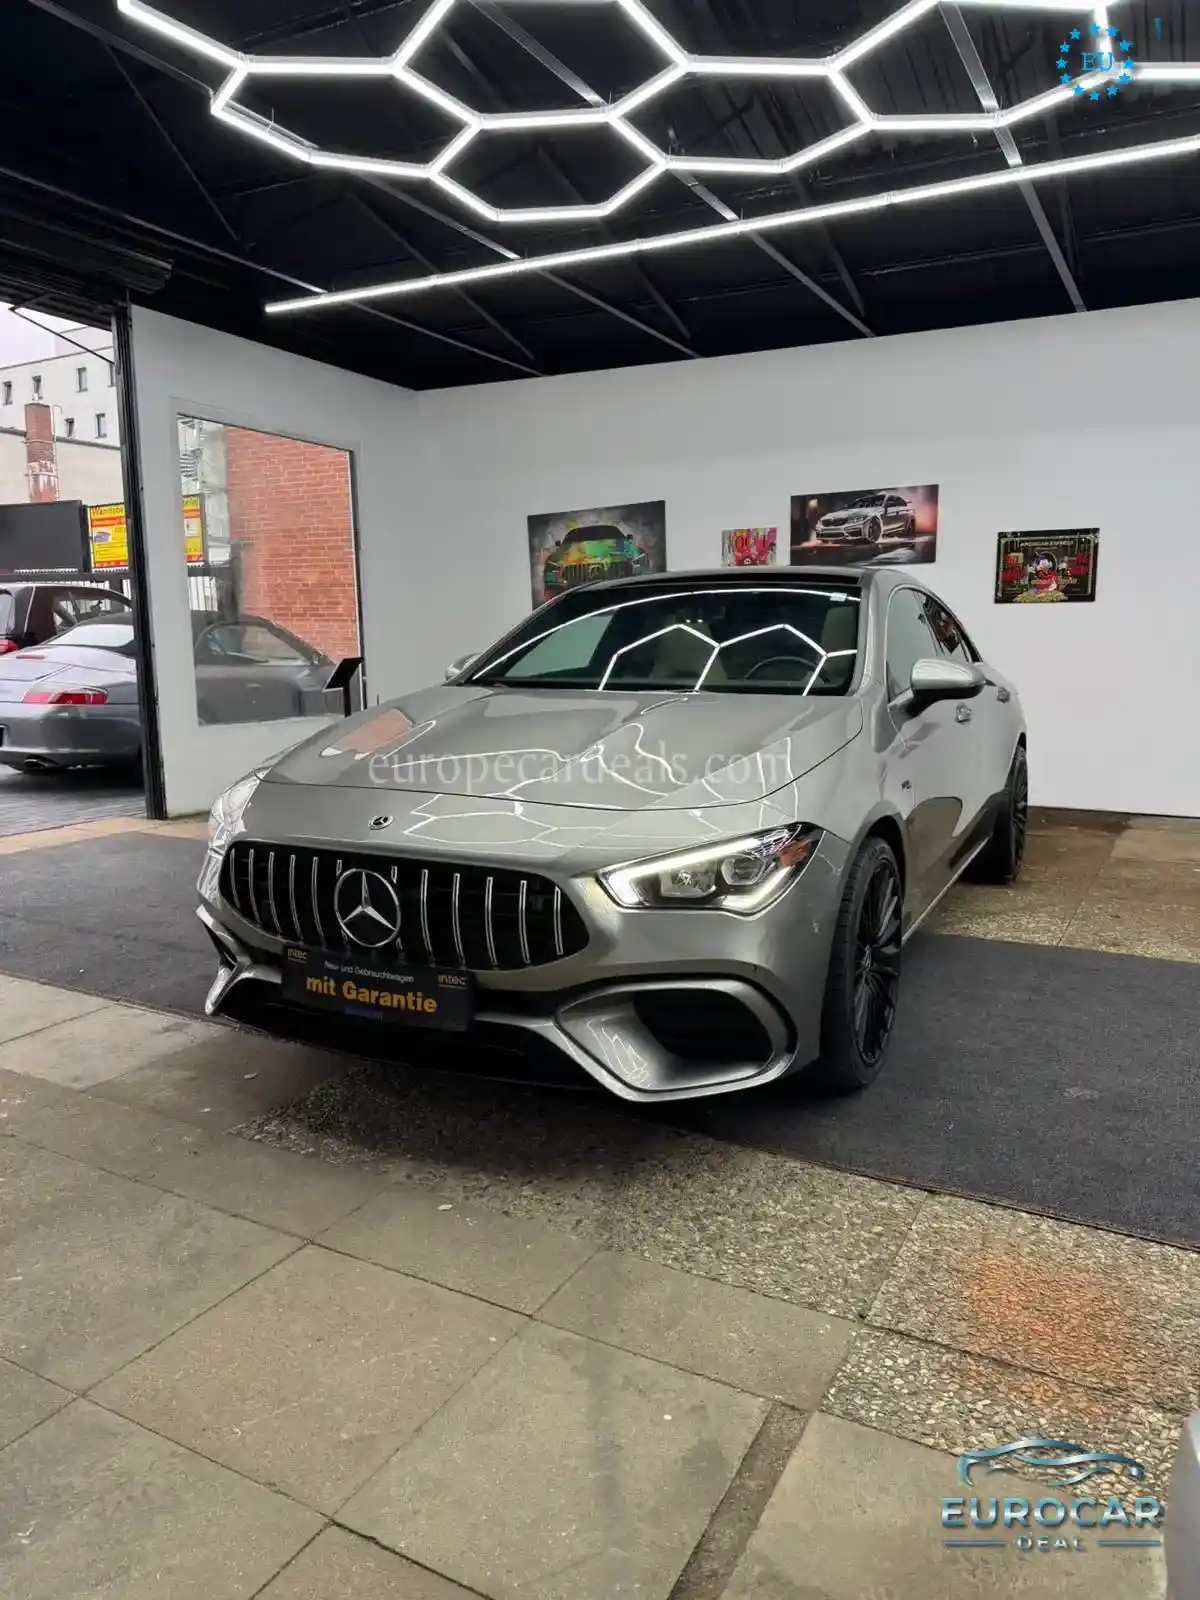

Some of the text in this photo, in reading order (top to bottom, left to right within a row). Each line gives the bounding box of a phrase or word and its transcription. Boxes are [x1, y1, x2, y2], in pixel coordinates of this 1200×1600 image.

[340, 963, 353, 974] und
[354, 966, 415, 984] Gebrauchtwagen
[306, 975, 337, 996] mit
[342, 981, 438, 1013] Garantie
